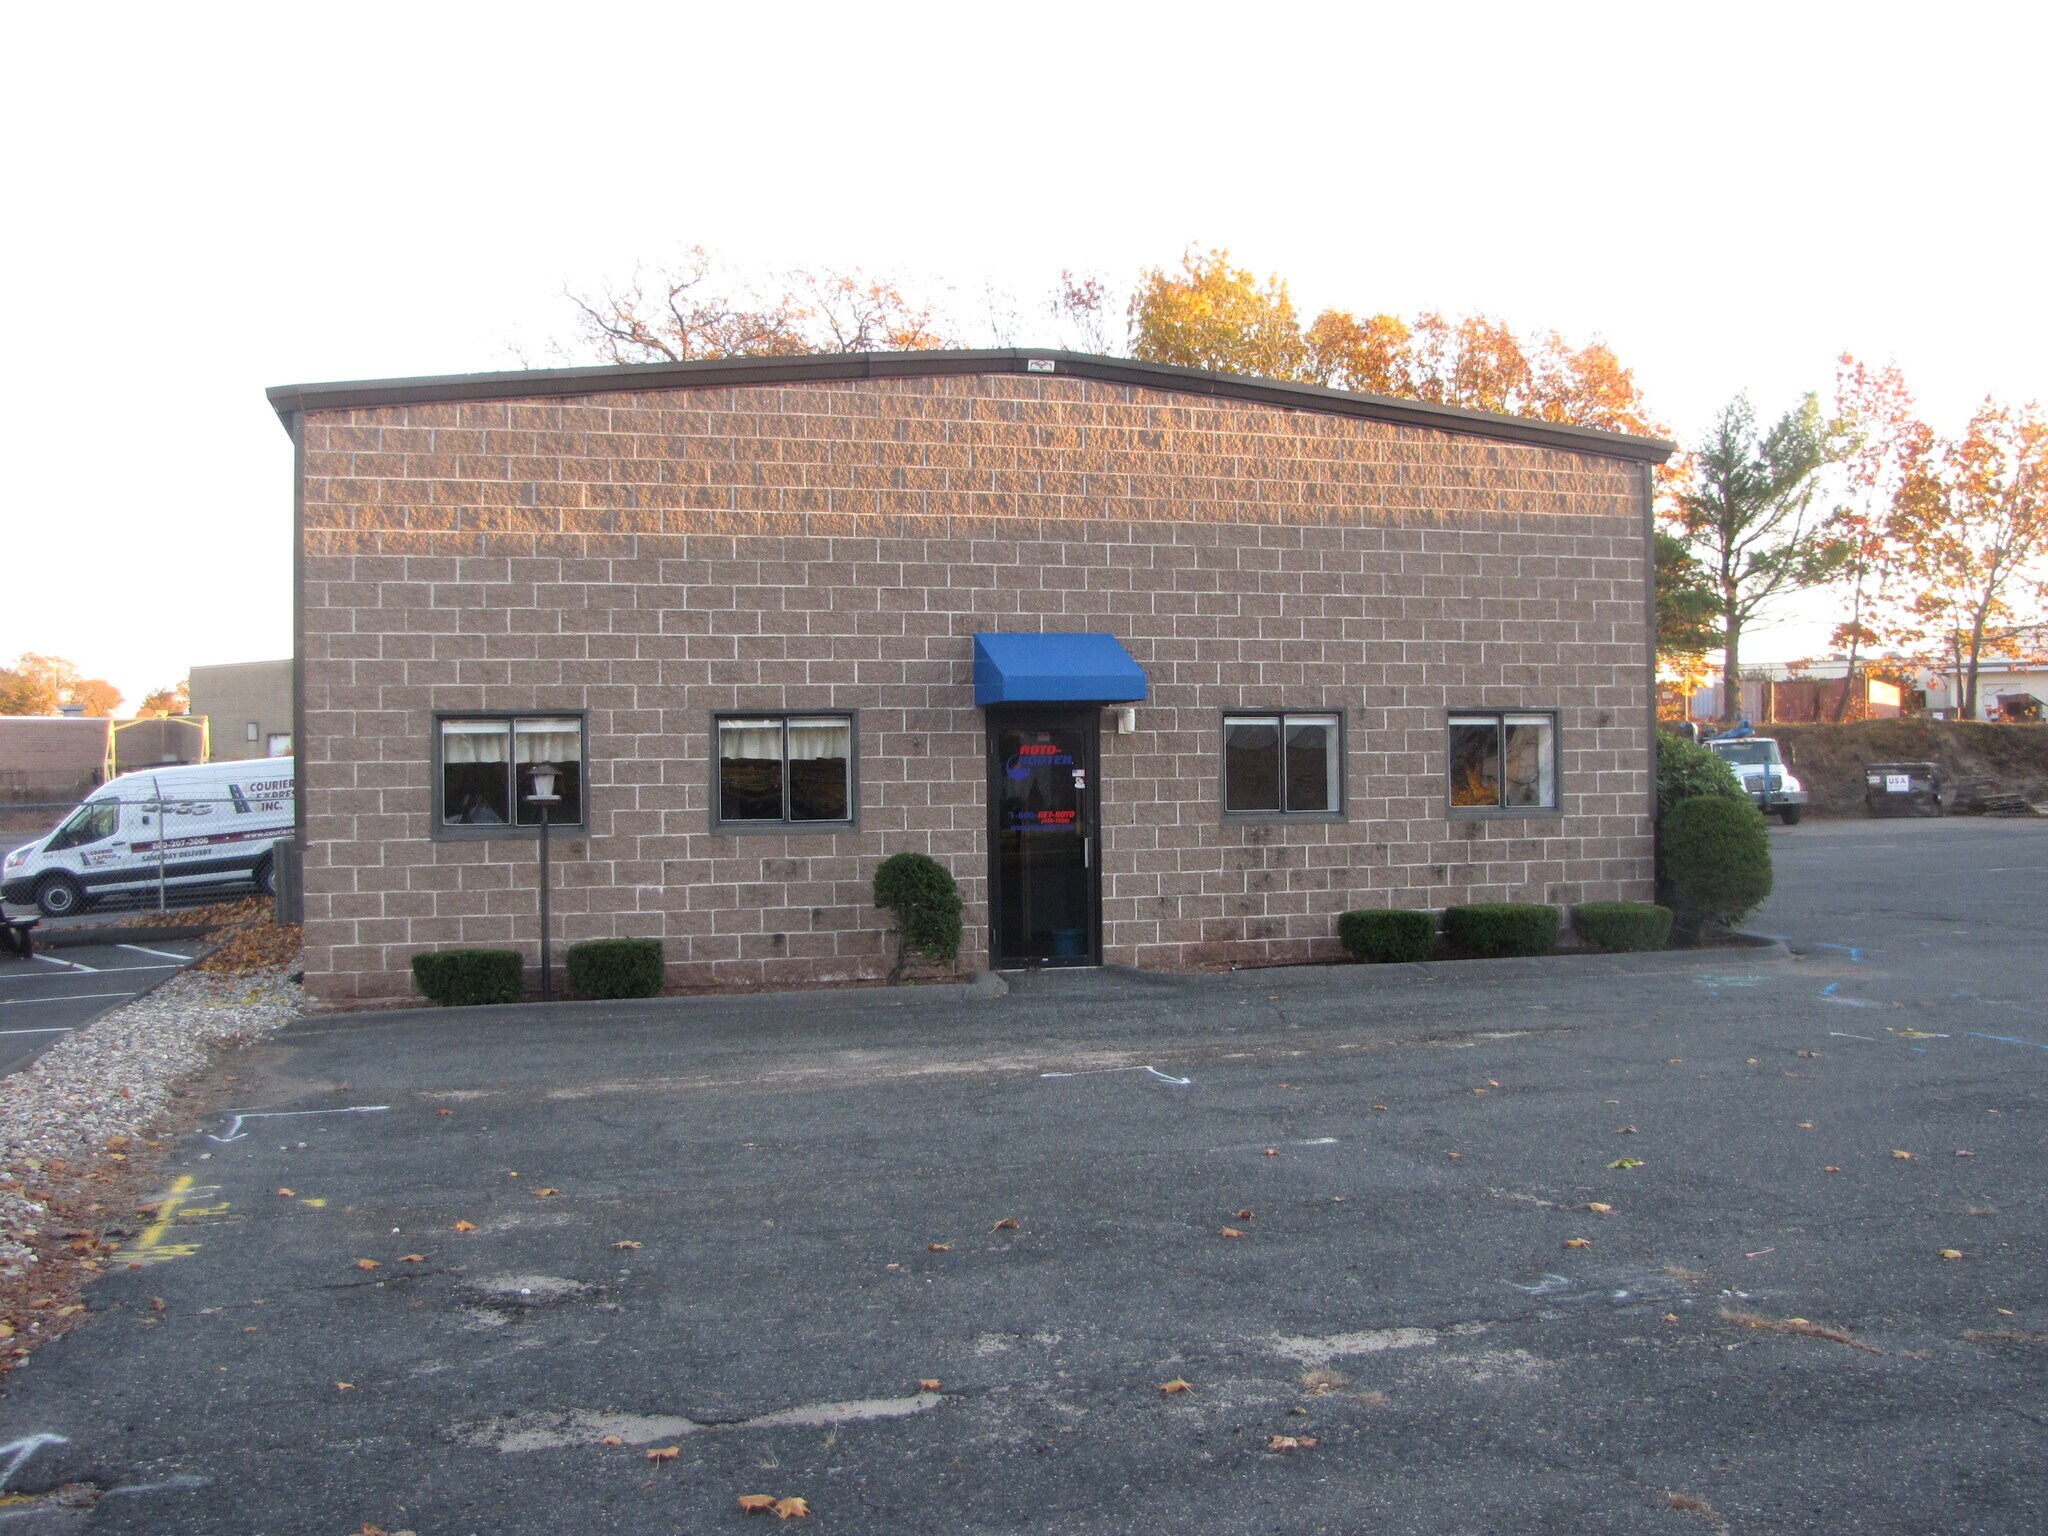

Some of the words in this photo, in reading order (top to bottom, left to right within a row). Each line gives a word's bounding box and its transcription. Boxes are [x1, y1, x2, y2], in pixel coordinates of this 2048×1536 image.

[250, 779, 295, 792] COURIER
[261, 801, 283, 811] INC.
[163, 851, 179, 860] DAY
[180, 848, 212, 858] DELIVERY
